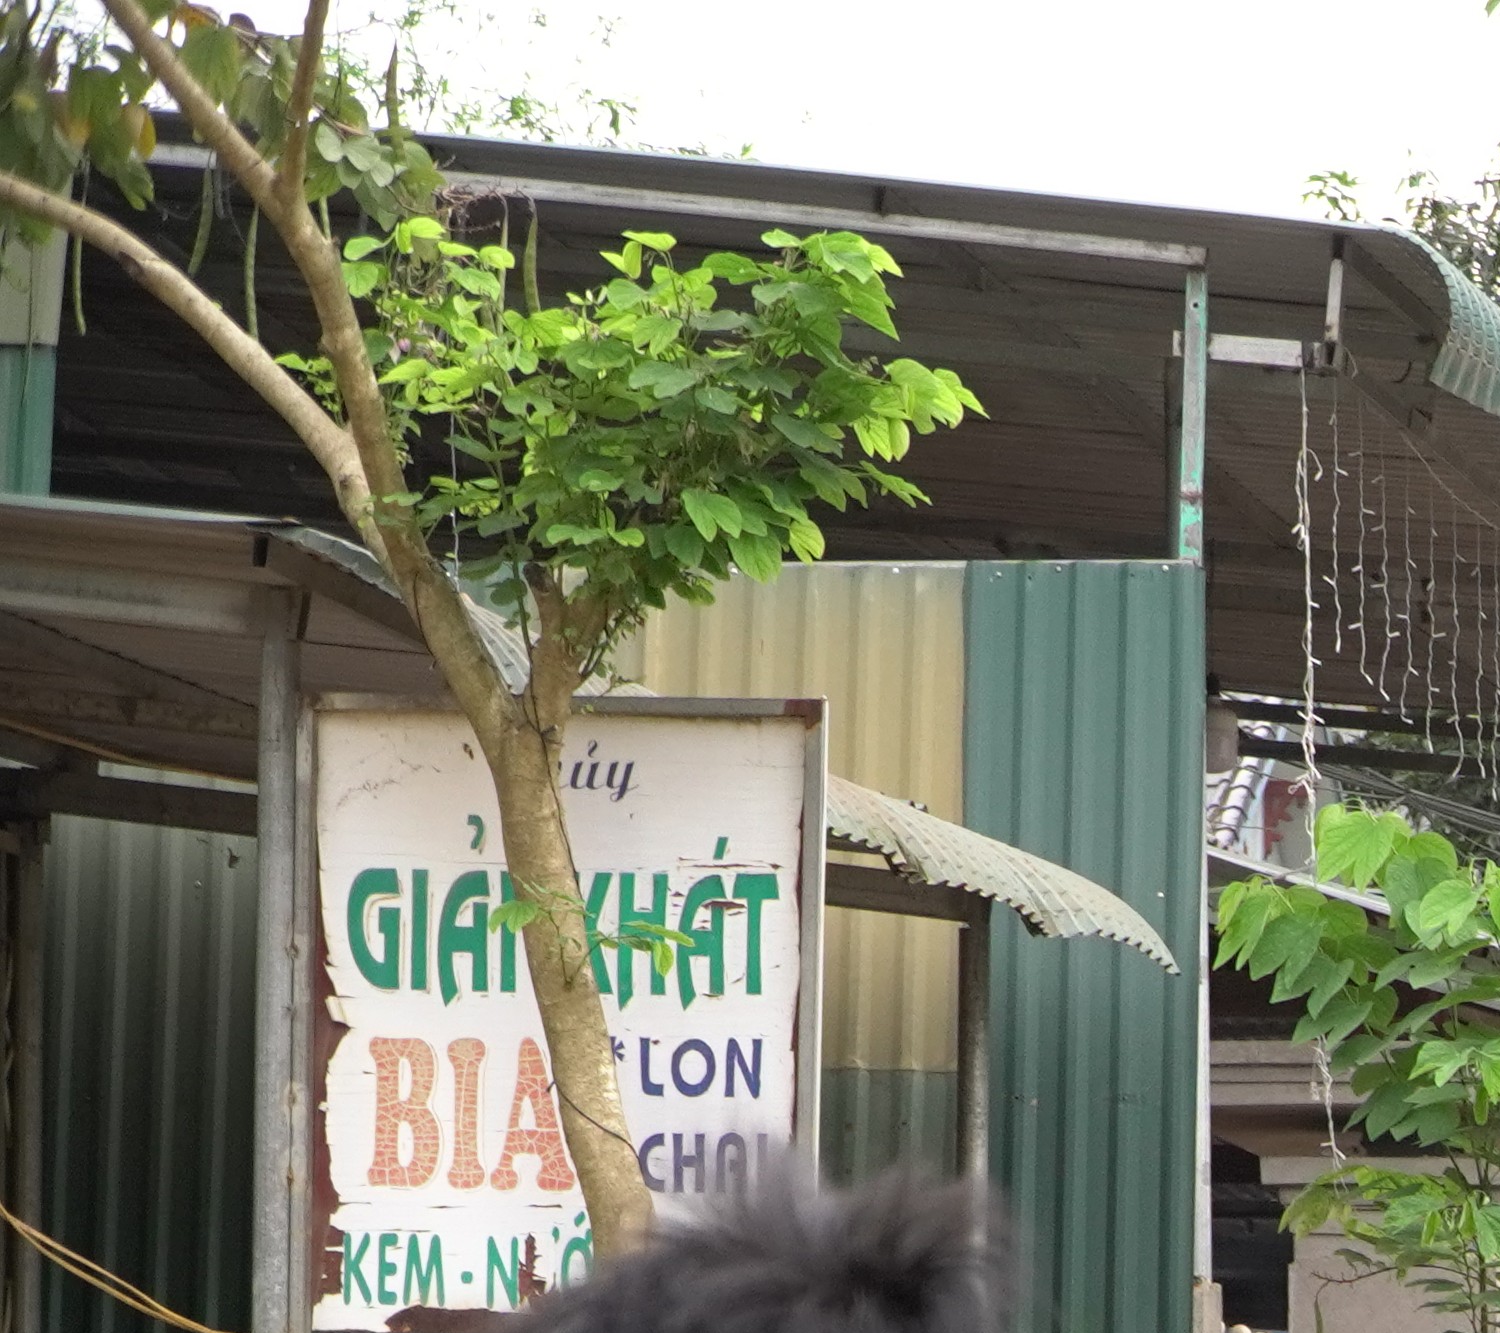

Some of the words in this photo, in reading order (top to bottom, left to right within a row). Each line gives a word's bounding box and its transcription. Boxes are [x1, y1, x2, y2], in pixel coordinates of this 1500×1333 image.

[638, 1035, 763, 1099] LON
[366, 1034, 576, 1192] BIA
[342, 1231, 446, 1308] KEM
